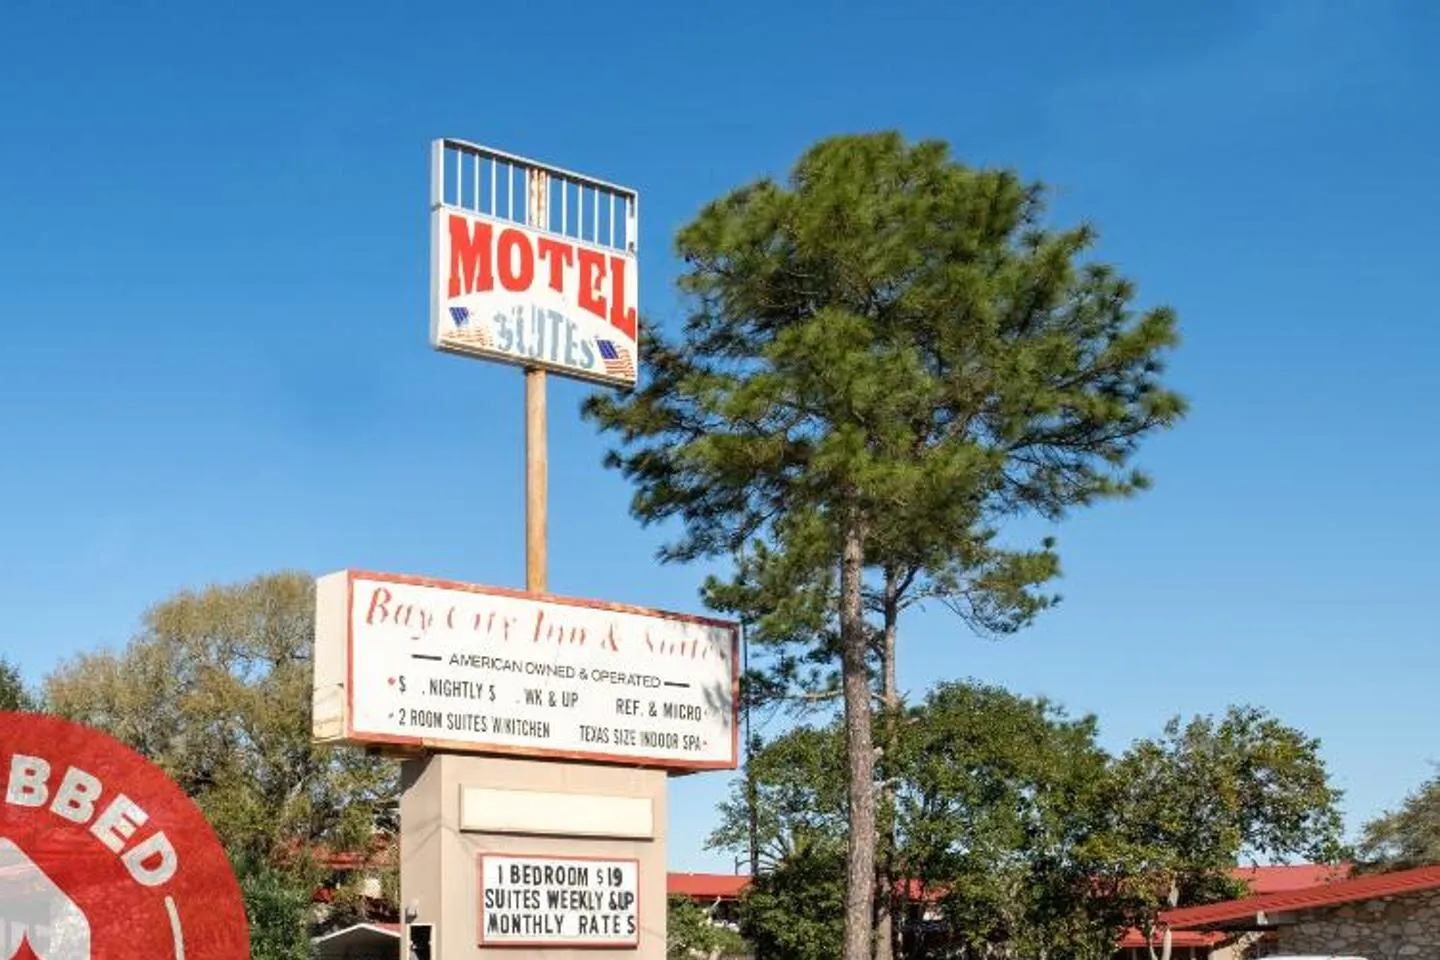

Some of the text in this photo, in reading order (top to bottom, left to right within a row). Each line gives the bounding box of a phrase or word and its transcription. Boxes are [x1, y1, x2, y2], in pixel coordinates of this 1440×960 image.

[448, 214, 636, 343] MOTEL
[494, 303, 595, 369] SUITES
[449, 653, 661, 688] AMERICAN OWNED & OPERATED
[429, 678, 483, 700] NIGHTLY
[524, 689, 542, 707] WK
[548, 690, 557, 708] &
[562, 692, 578, 708] UP
[399, 708, 406, 726] 2
[410, 709, 442, 728] ROOM
[447, 713, 488, 732] SUITES
[648, 701, 658, 718] &
[663, 702, 702, 721] MICRO
[579, 725, 609, 744] TEXAS
[613, 728, 636, 746] SIZE
[683, 735, 700, 751] SPA
[510, 864, 588, 887] BEDROOM
[485, 888, 540, 909] SUITES
[547, 890, 603, 911] WEEKLY
[487, 913, 636, 934] MONTHLY RATES
